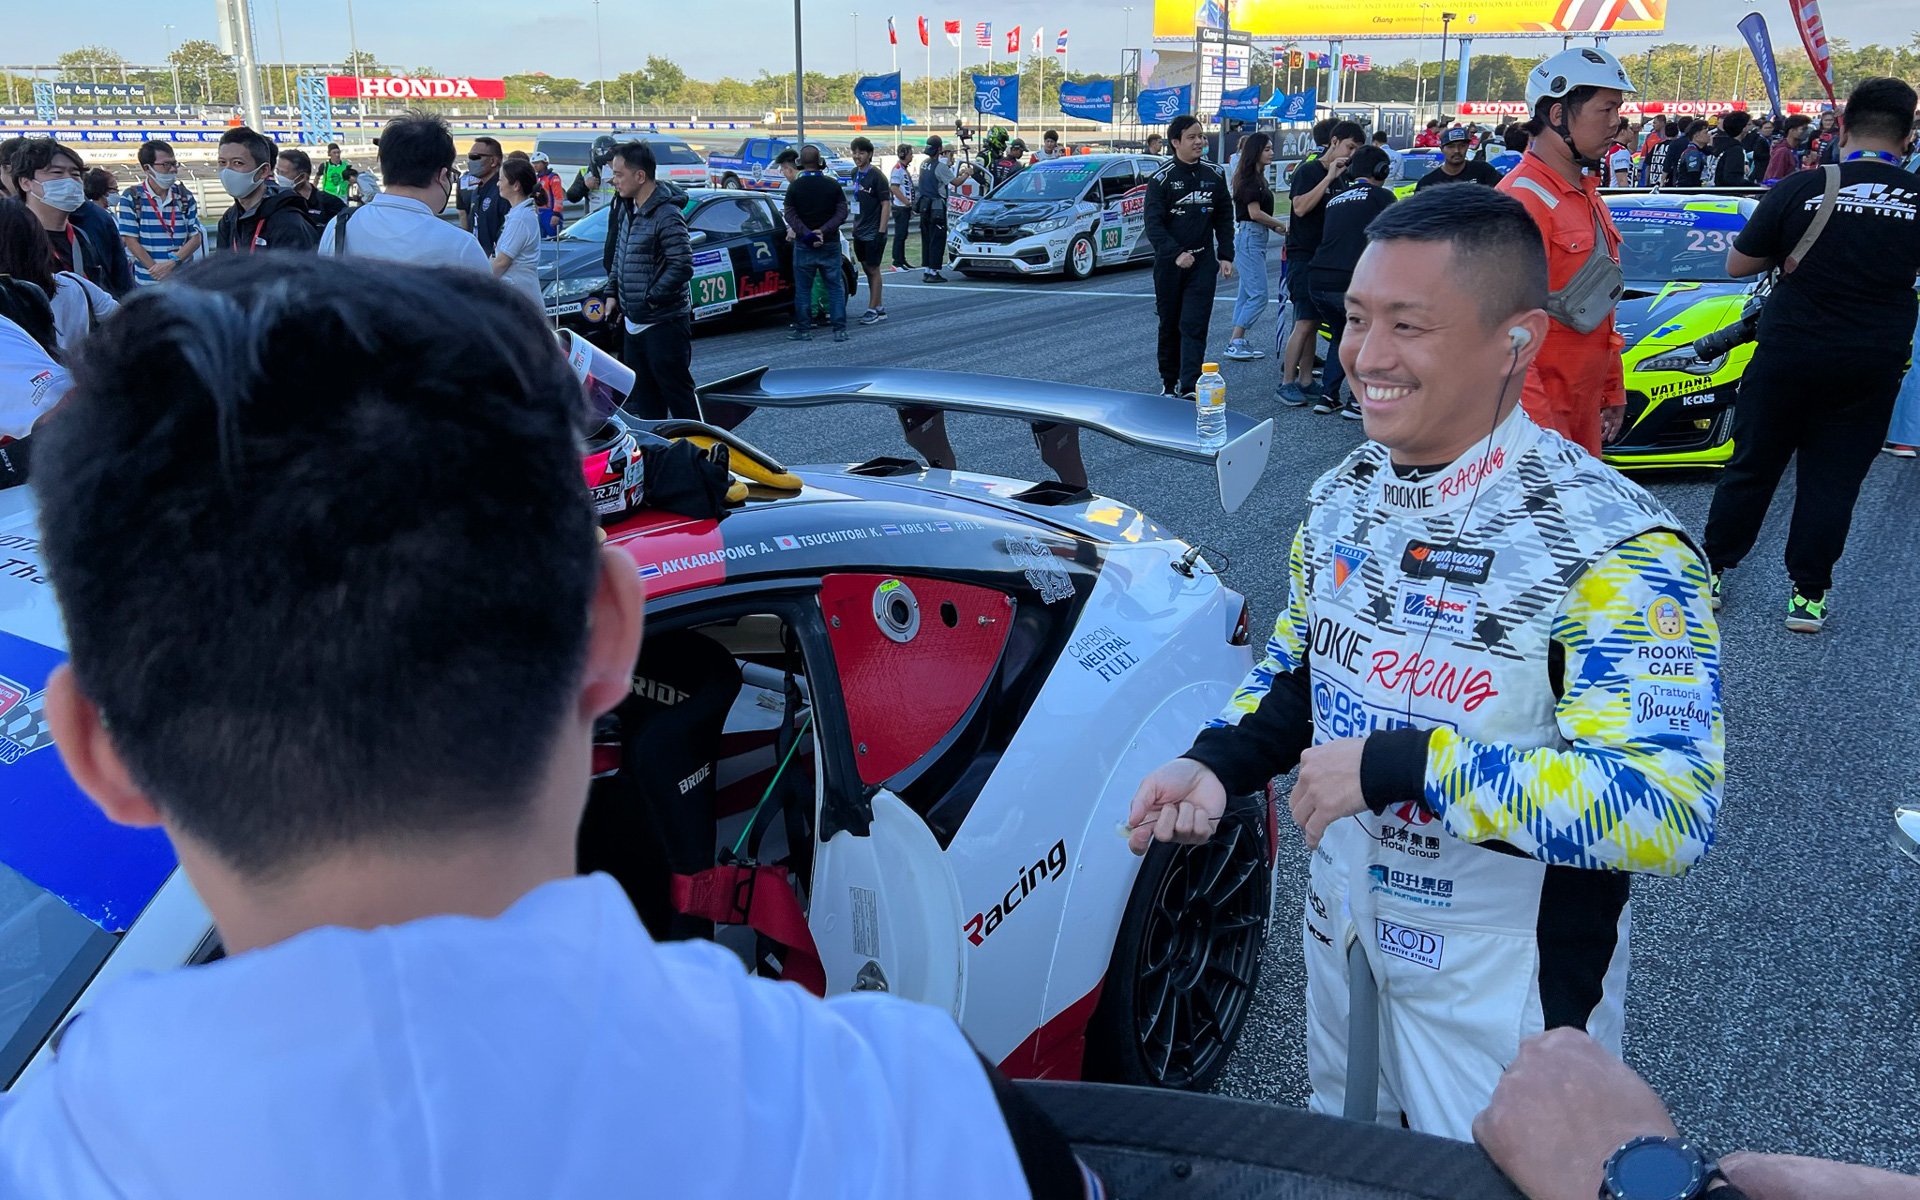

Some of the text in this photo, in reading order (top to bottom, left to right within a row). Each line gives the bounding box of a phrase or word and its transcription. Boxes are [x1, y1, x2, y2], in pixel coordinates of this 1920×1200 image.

[1372, 15, 1394, 24] Chang
[1203, 28, 1219, 41] Chang
[360, 78, 478, 97] HONDA
[1471, 103, 1529, 114] HOND
[1663, 102, 1735, 113] HONDA
[1875, 207, 1915, 220] TEAM
[1105, 230, 1119, 248] 393
[699, 276, 727, 303] 379
[1650, 376, 1712, 396] VATTANA
[1651, 382, 1713, 401] MOTORSPORT
[1383, 447, 1506, 509] ROOKIE RACING
[661, 543, 756, 575] AKKARAPONG
[758, 541, 774, 554] A.
[798, 528, 867, 548] TSUCHITORI
[871, 526, 883, 538] K.
[900, 522, 924, 534] KRIS
[926, 521, 936, 532] V.
[955, 521, 973, 531] PITI
[1454, 565, 1482, 575] emotion
[1425, 595, 1467, 612] Super
[1067, 625, 1115, 658] CARBON
[1078, 635, 1131, 671] NEUTRAL
[1638, 646, 1698, 660] ROOKIE
[1096, 651, 1140, 683] FUEL
[1648, 662, 1694, 676] CAFE
[1366, 650, 1499, 712] RACING
[1650, 685, 1701, 699] Trattoria
[1637, 692, 1711, 730] Bourbon
[678, 762, 711, 795] BRIDE
[1381, 825, 1440, 850] 和泰集團
[1381, 839, 1441, 859] Hotai Group
[1391, 870, 1453, 893] 中升集团
[963, 838, 1067, 947] Racing
[1411, 952, 1434, 964] STUDIO
